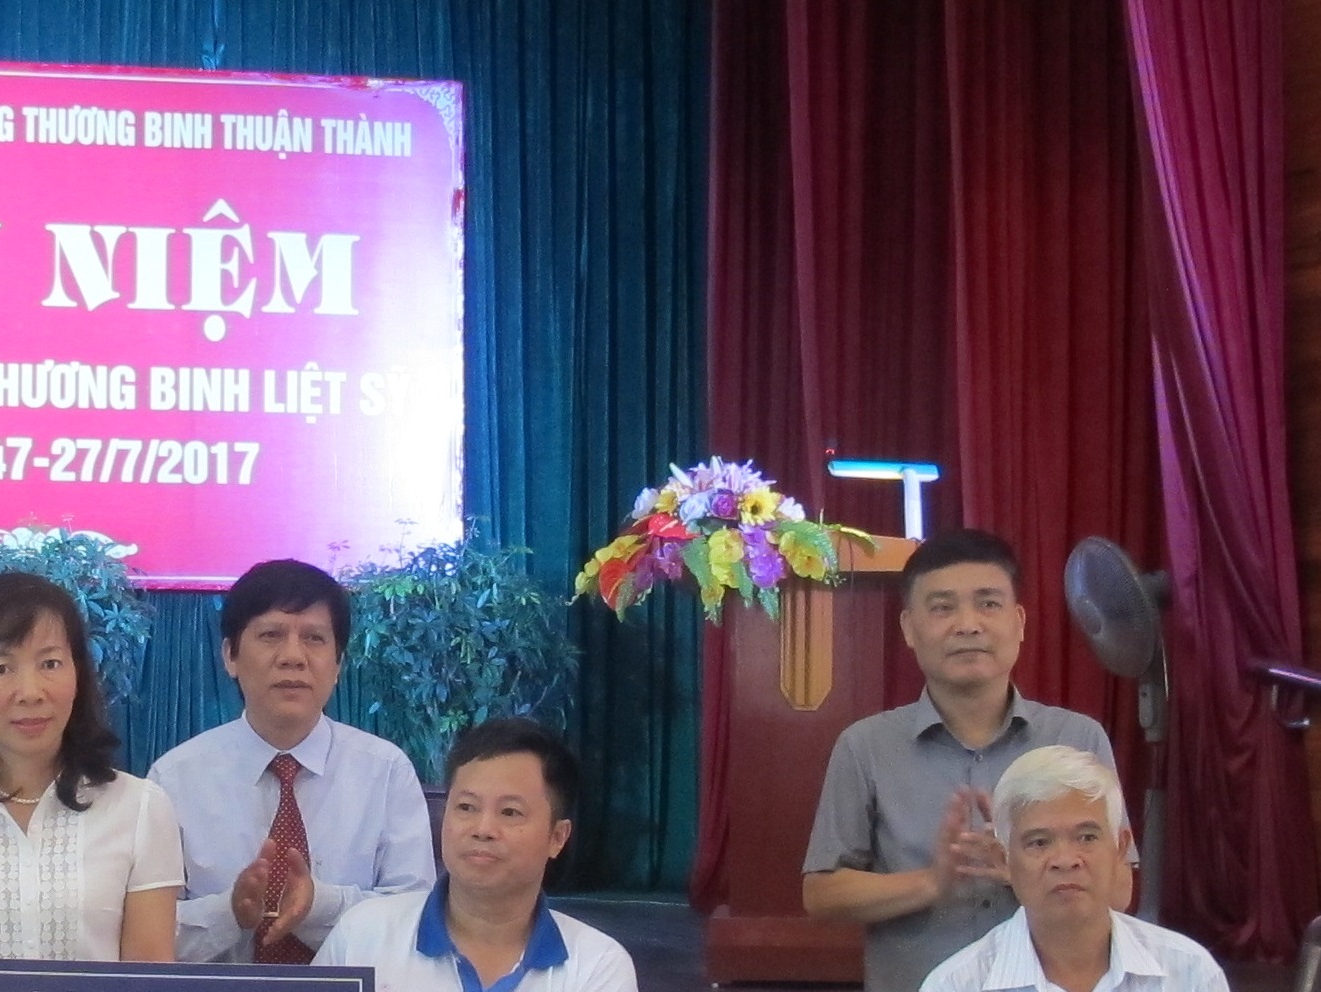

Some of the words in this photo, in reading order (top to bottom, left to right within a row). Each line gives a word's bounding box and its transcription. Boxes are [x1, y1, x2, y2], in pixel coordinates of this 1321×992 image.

[22, 105, 136, 147] THƯƠNG
[144, 111, 213, 149] BINH
[220, 109, 313, 160] THUẬN
[320, 113, 412, 157] THÀNH
[41, 198, 360, 342] NIỆM
[150, 367, 250, 413] BINH
[264, 361, 347, 424] LIỆT
